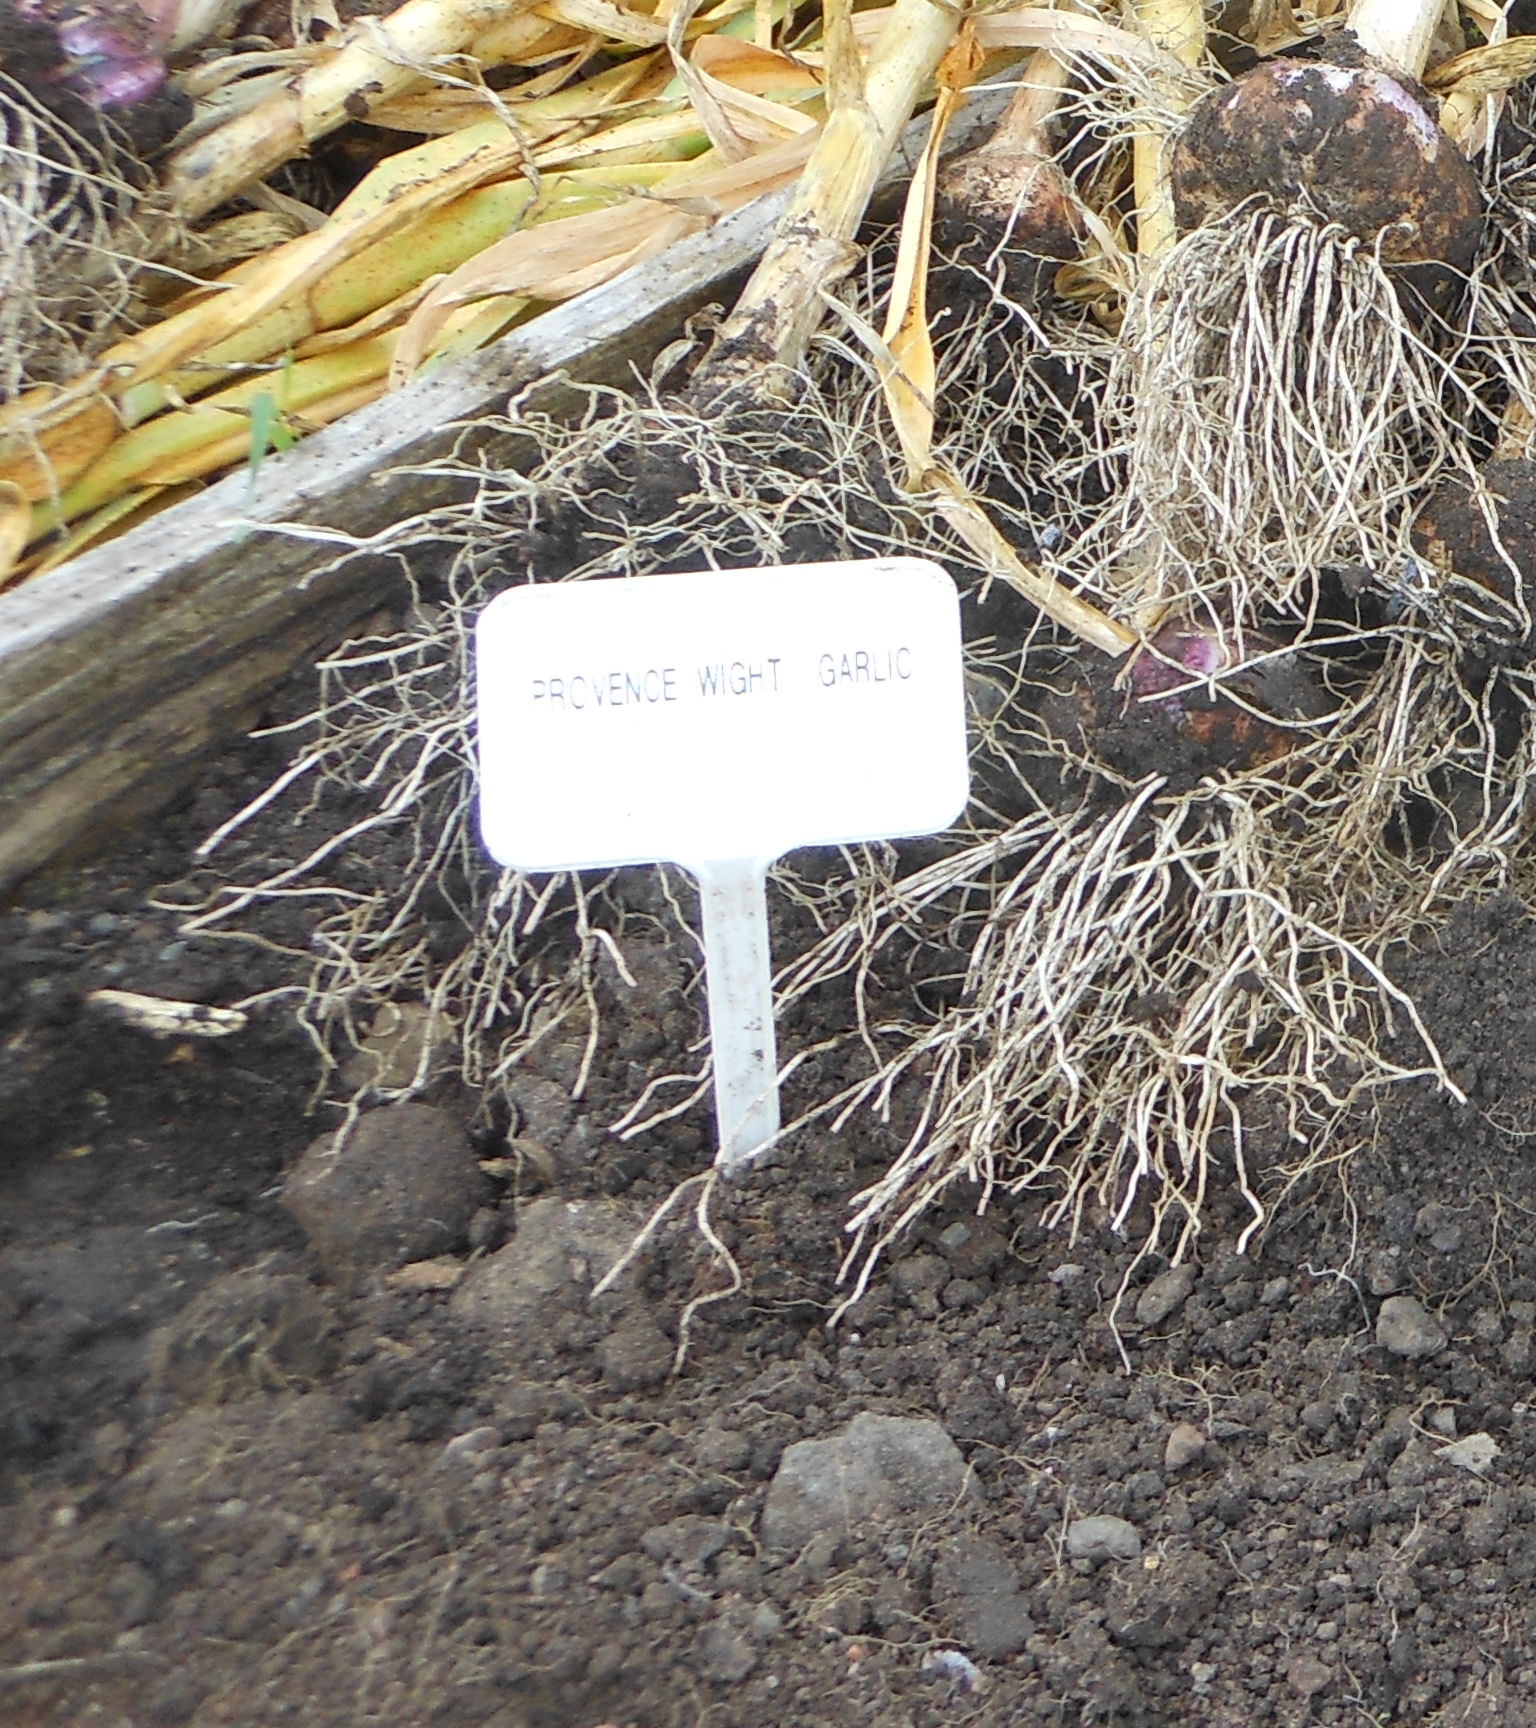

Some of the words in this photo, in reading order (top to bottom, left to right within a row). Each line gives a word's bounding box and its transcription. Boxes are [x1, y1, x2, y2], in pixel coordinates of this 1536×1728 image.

[532, 667, 678, 710] PROVENCE
[697, 657, 782, 697] WIGHT
[817, 646, 912, 687] GARLIC
